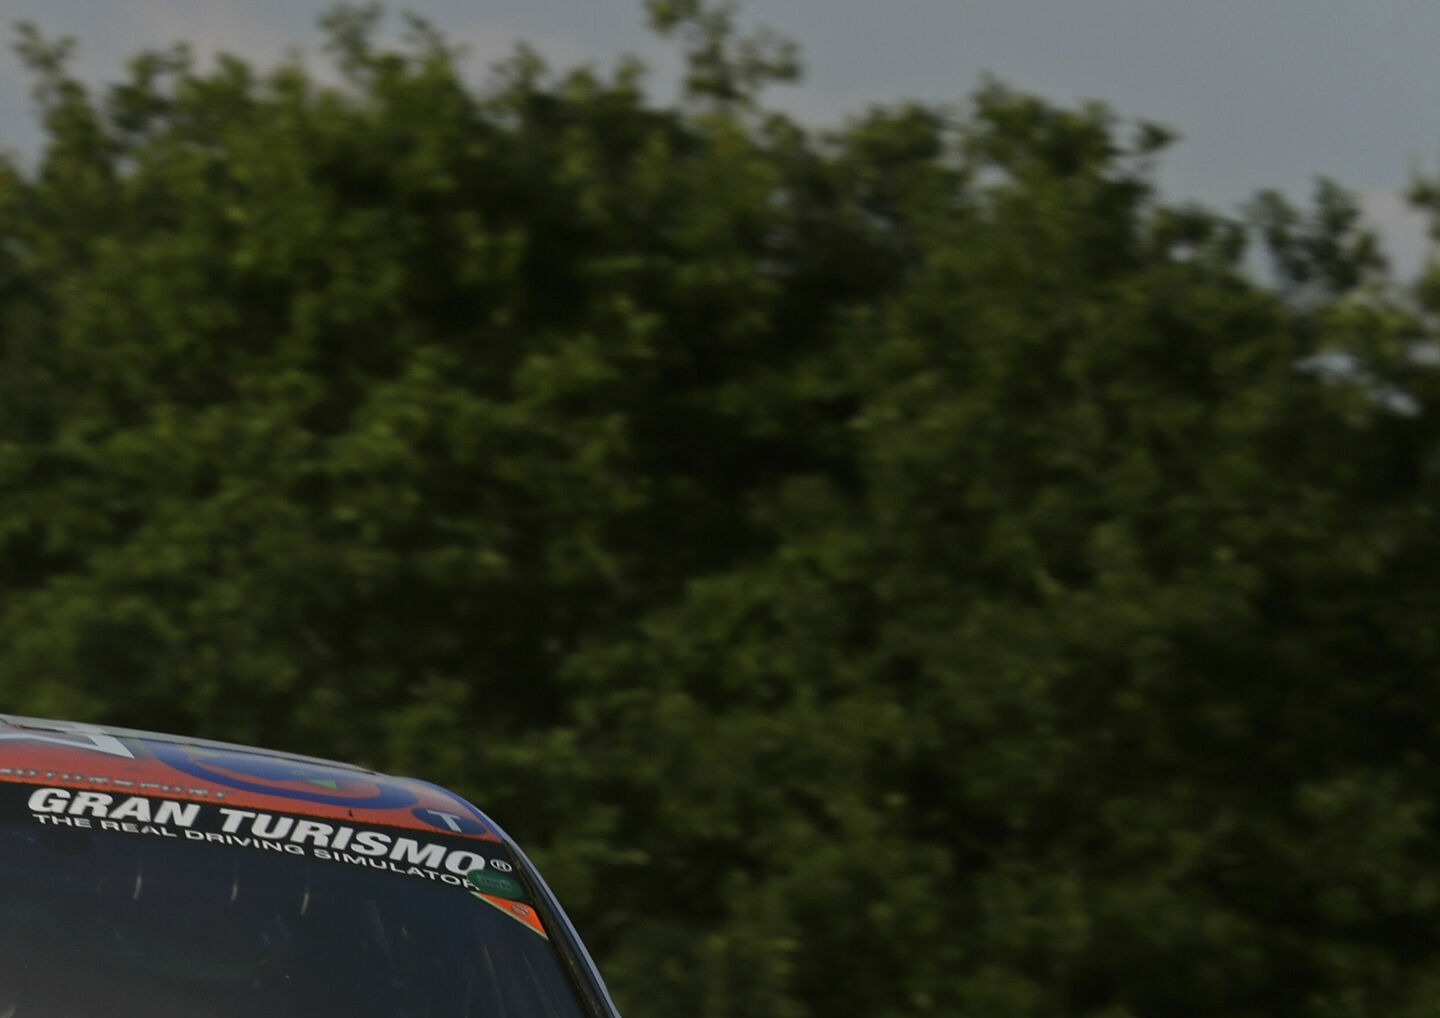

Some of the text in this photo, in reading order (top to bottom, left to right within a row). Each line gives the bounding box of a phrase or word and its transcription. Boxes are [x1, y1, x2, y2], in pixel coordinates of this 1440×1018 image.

[27, 787, 486, 876] GRAN TURISMO
[32, 813, 92, 829] THE
[101, 819, 178, 838] REAL
[184, 828, 306, 856] DRIVING
[313, 847, 480, 891] SIMULATOR
